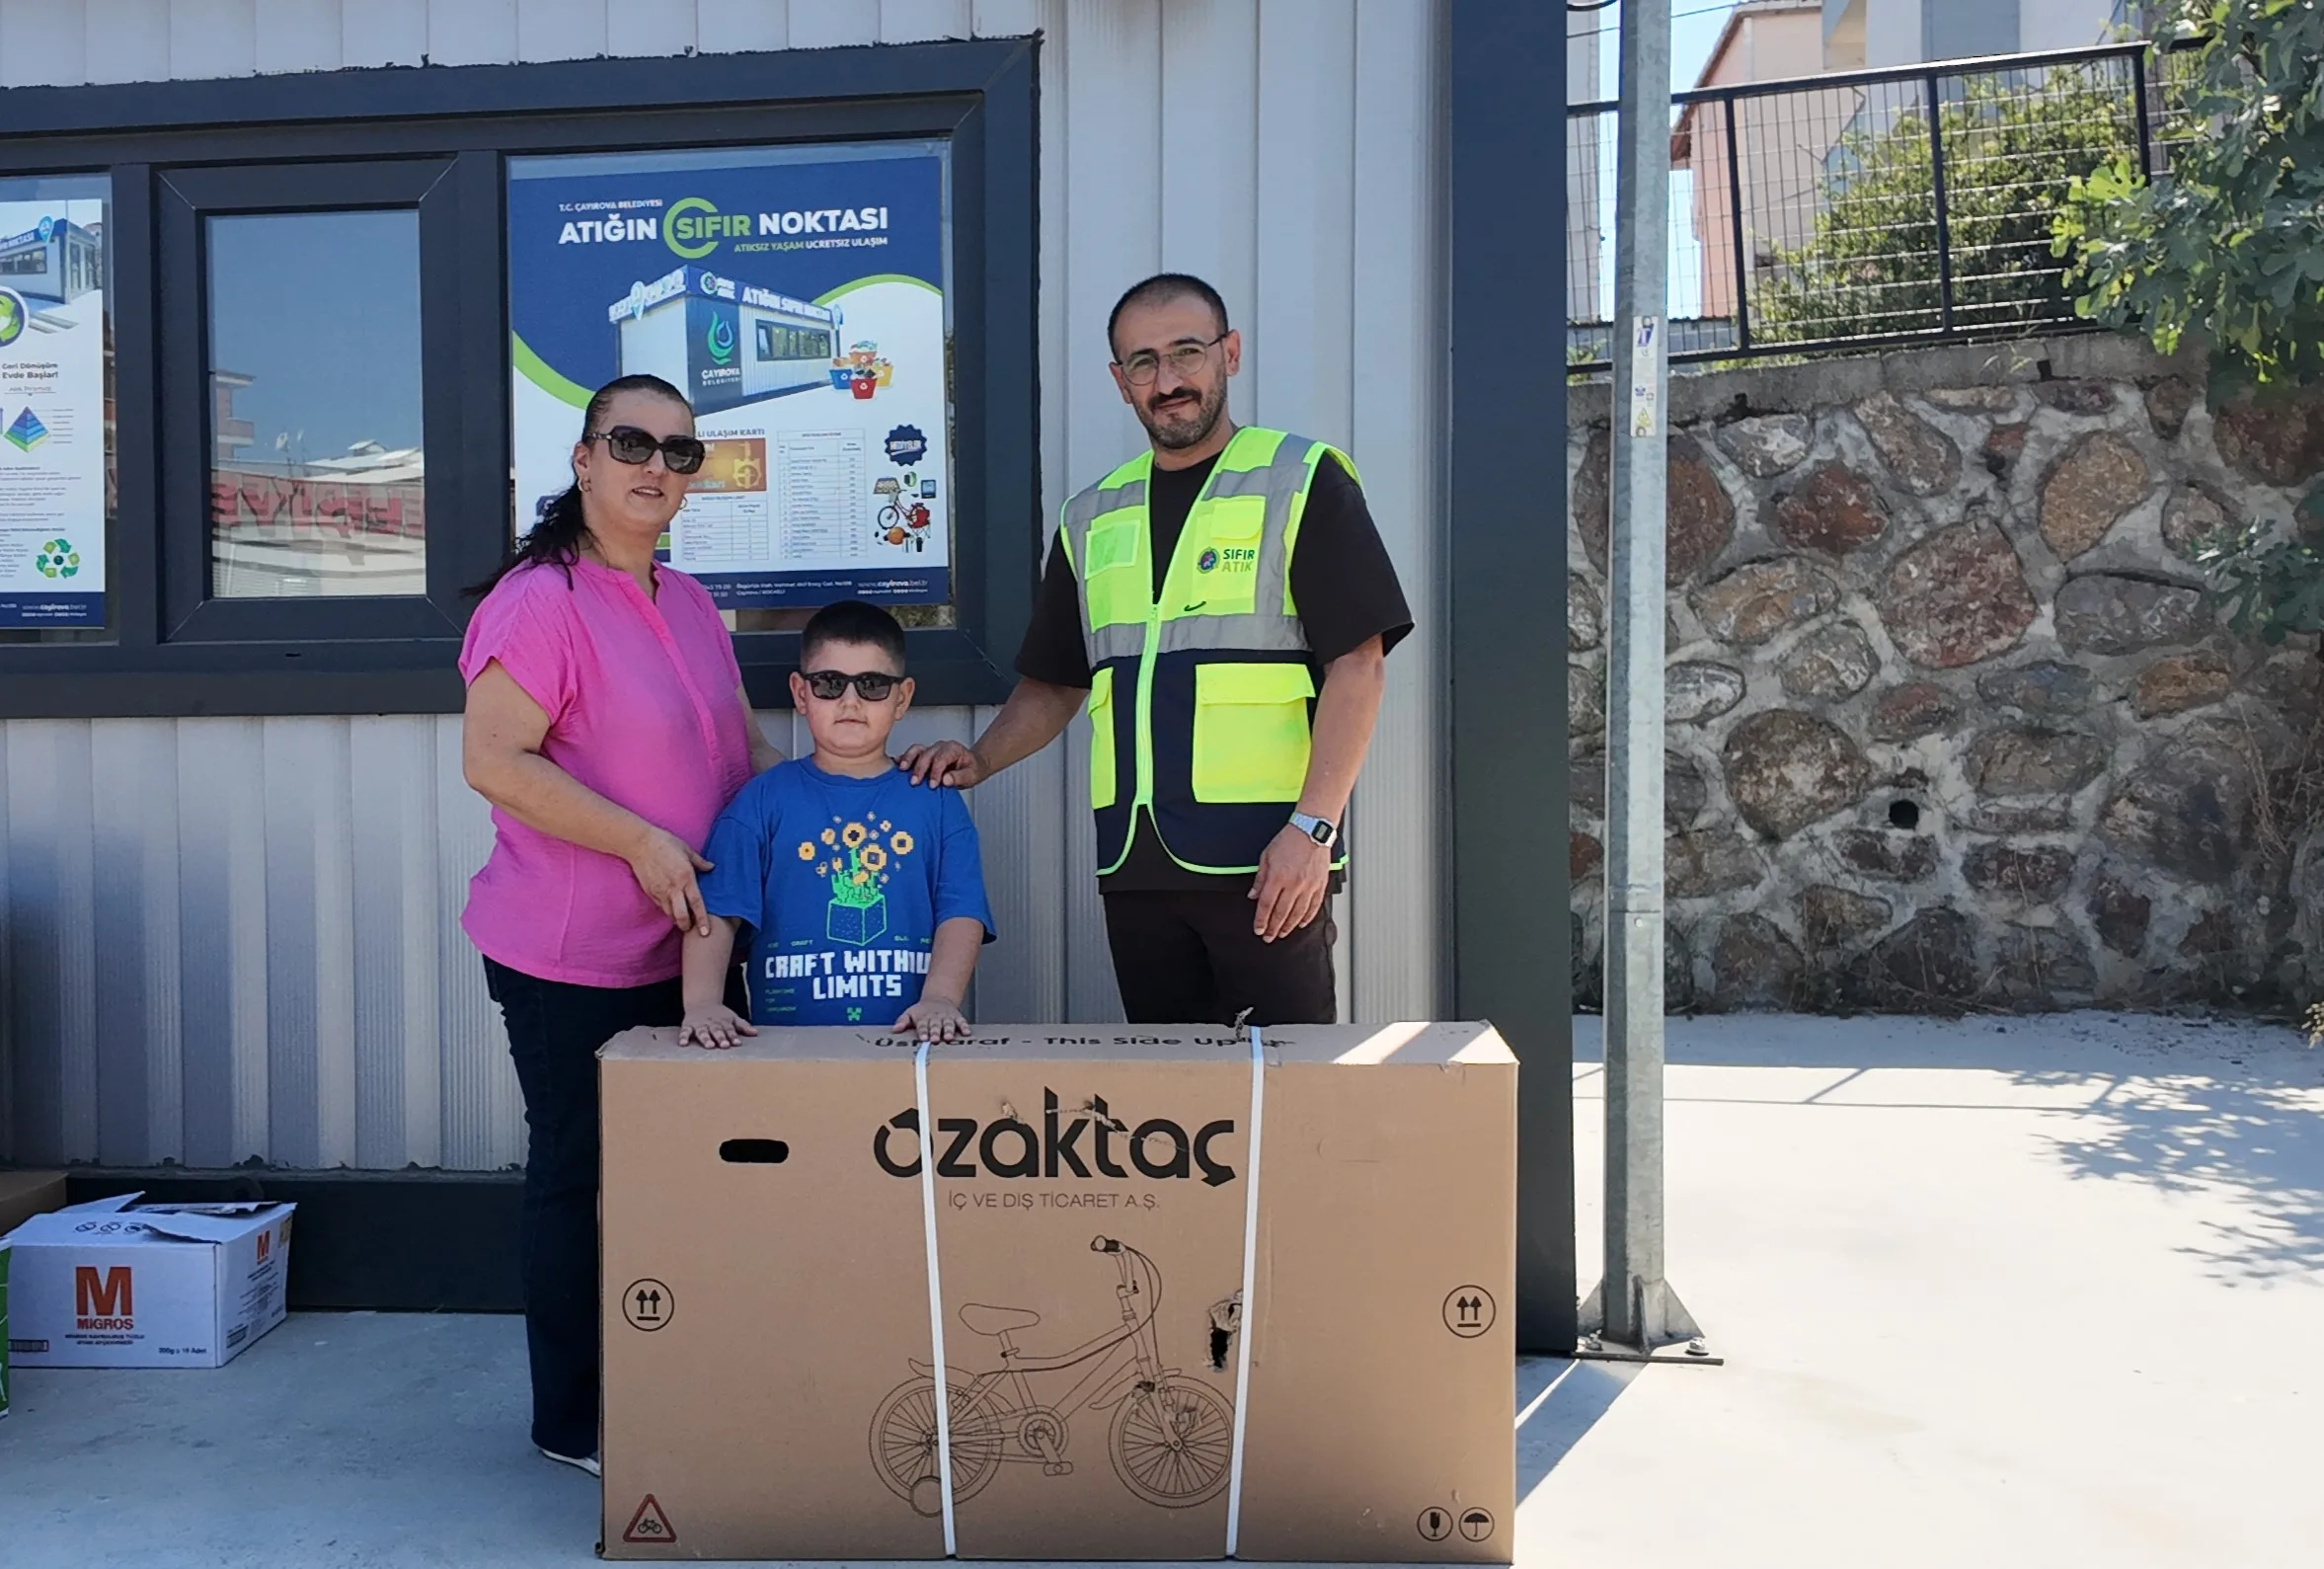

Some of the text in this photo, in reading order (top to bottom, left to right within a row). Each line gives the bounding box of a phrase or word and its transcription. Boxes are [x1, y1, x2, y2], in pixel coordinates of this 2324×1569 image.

[558, 206, 889, 244] ATIĞIN SIFIR NOKTASI
[771, 241, 805, 253] YAŞAM
[851, 236, 888, 248] ULAŞIM
[1223, 548, 1255, 560] SIFIR
[1221, 561, 1253, 573] ATIK
[765, 951, 835, 979] CRAFT
[813, 974, 902, 1000] LIMITS
[942, 1037, 1011, 1047] araf
[1044, 1037, 1101, 1046] This
[1113, 1037, 1182, 1046] Side
[948, 1191, 1160, 1212] İÇ VE DIŞ TİCARET A.Ş.
[75, 1266, 133, 1316] M
